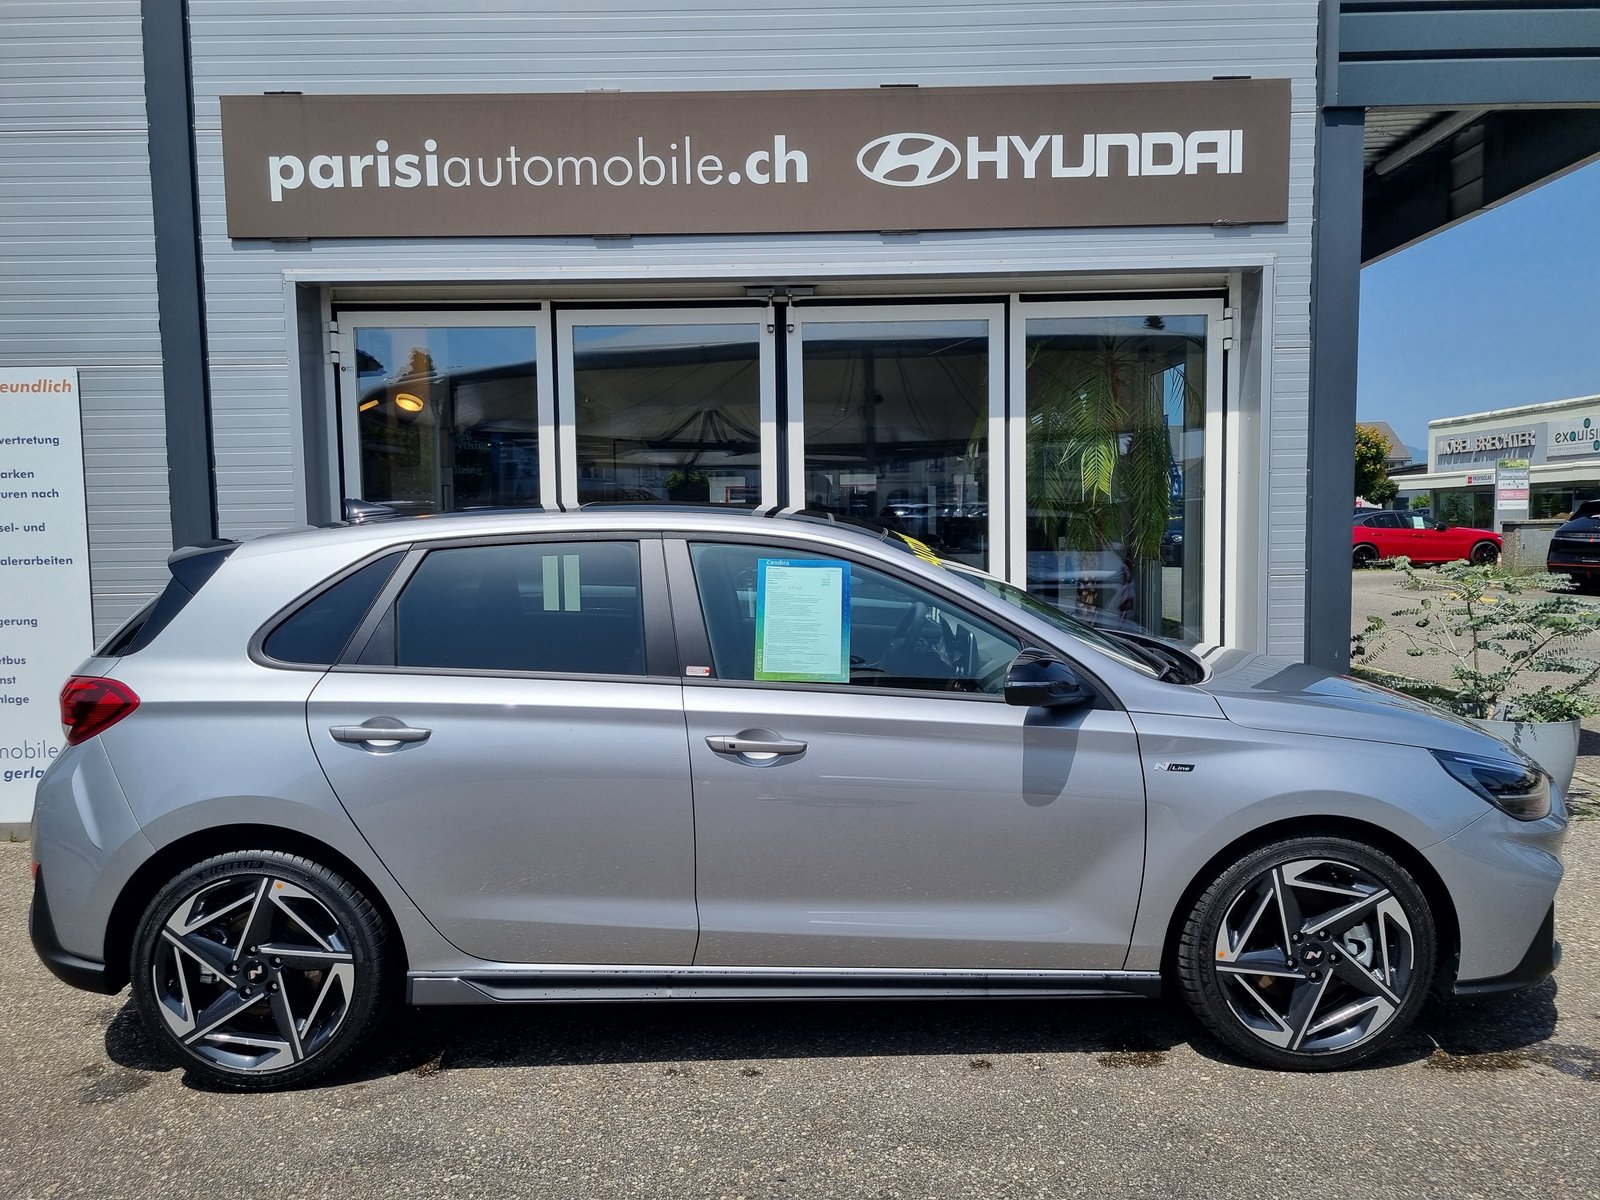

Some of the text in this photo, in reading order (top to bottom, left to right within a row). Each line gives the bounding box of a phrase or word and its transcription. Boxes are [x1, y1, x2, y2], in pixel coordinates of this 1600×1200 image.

[966, 129, 1243, 180] HYUNDAI
[268, 135, 808, 202] parisiautomobile.ch
[0, 469, 35, 479] arken
[31, 489, 60, 498] nach
[23, 522, 46, 532] und
[0, 556, 73, 565] alerarbeiten
[0, 656, 26, 665] tbus
